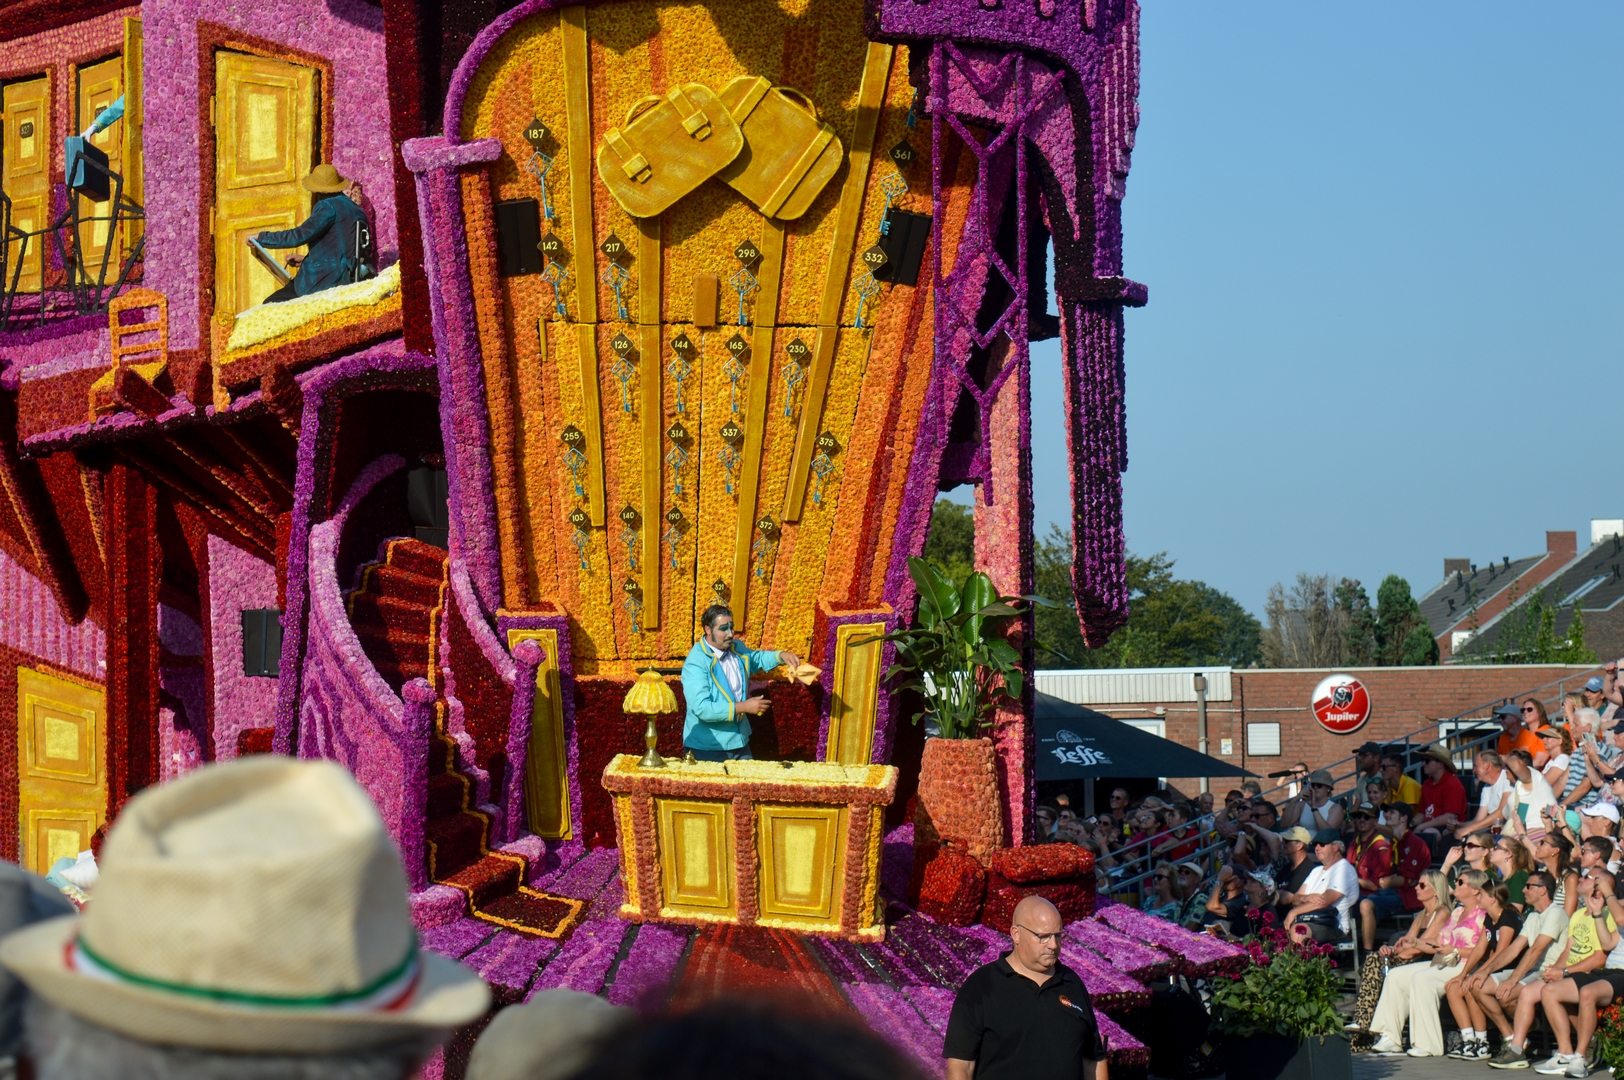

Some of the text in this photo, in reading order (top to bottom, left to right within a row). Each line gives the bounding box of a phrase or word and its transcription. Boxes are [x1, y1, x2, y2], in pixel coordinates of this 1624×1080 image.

[528, 129, 545, 139] 187
[894, 150, 911, 160] 361
[542, 241, 558, 250] 142
[605, 243, 620, 252] 217
[737, 249, 756, 258] 298
[865, 253, 883, 263] 332
[614, 341, 628, 349] 126
[674, 341, 688, 349] 144
[729, 342, 743, 350] 165
[789, 345, 805, 353] 230
[564, 432, 580, 440] 255
[670, 430, 684, 438] 314
[818, 438, 834, 446] 375
[572, 514, 584, 522] 103
[622, 512, 635, 520] 140
[668, 512, 680, 520] 190
[759, 521, 773, 529] 372
[625, 583, 636, 591] 264
[1324, 712, 1359, 723] Jupiler
[1051, 745, 1106, 766] Leffe
